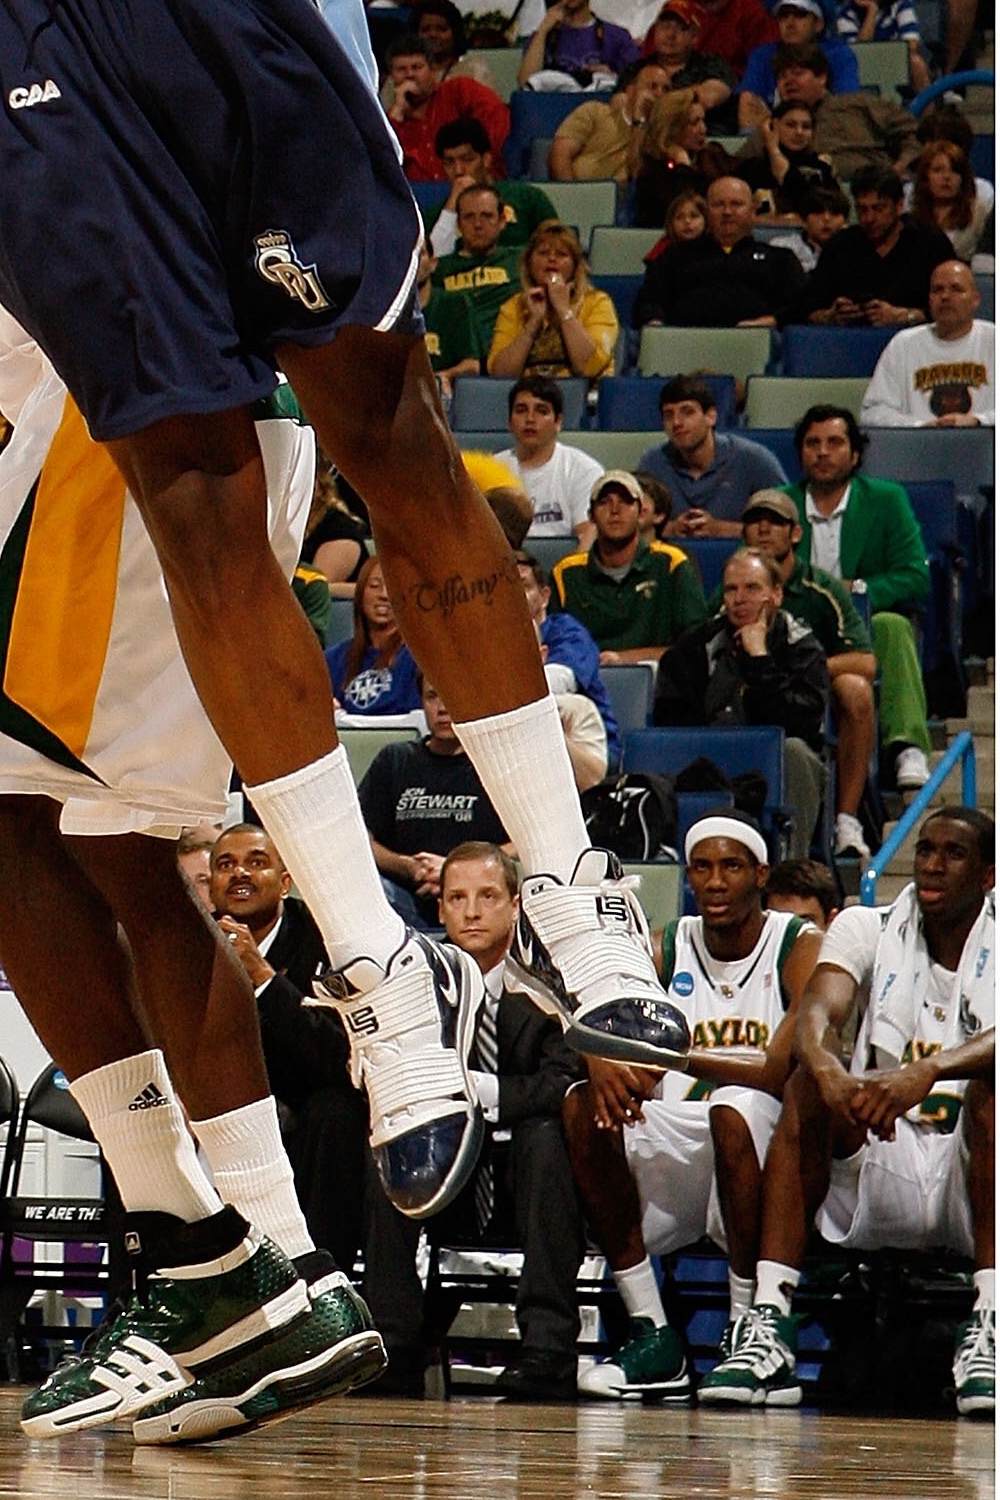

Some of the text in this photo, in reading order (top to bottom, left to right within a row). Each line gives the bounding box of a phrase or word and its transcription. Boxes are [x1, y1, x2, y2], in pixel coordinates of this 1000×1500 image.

[8, 79, 61, 110] CAA
[408, 572, 500, 619] Tiffany
[395, 795, 478, 811] STEWART
[25, 1206, 104, 1221] WE ARE THE
